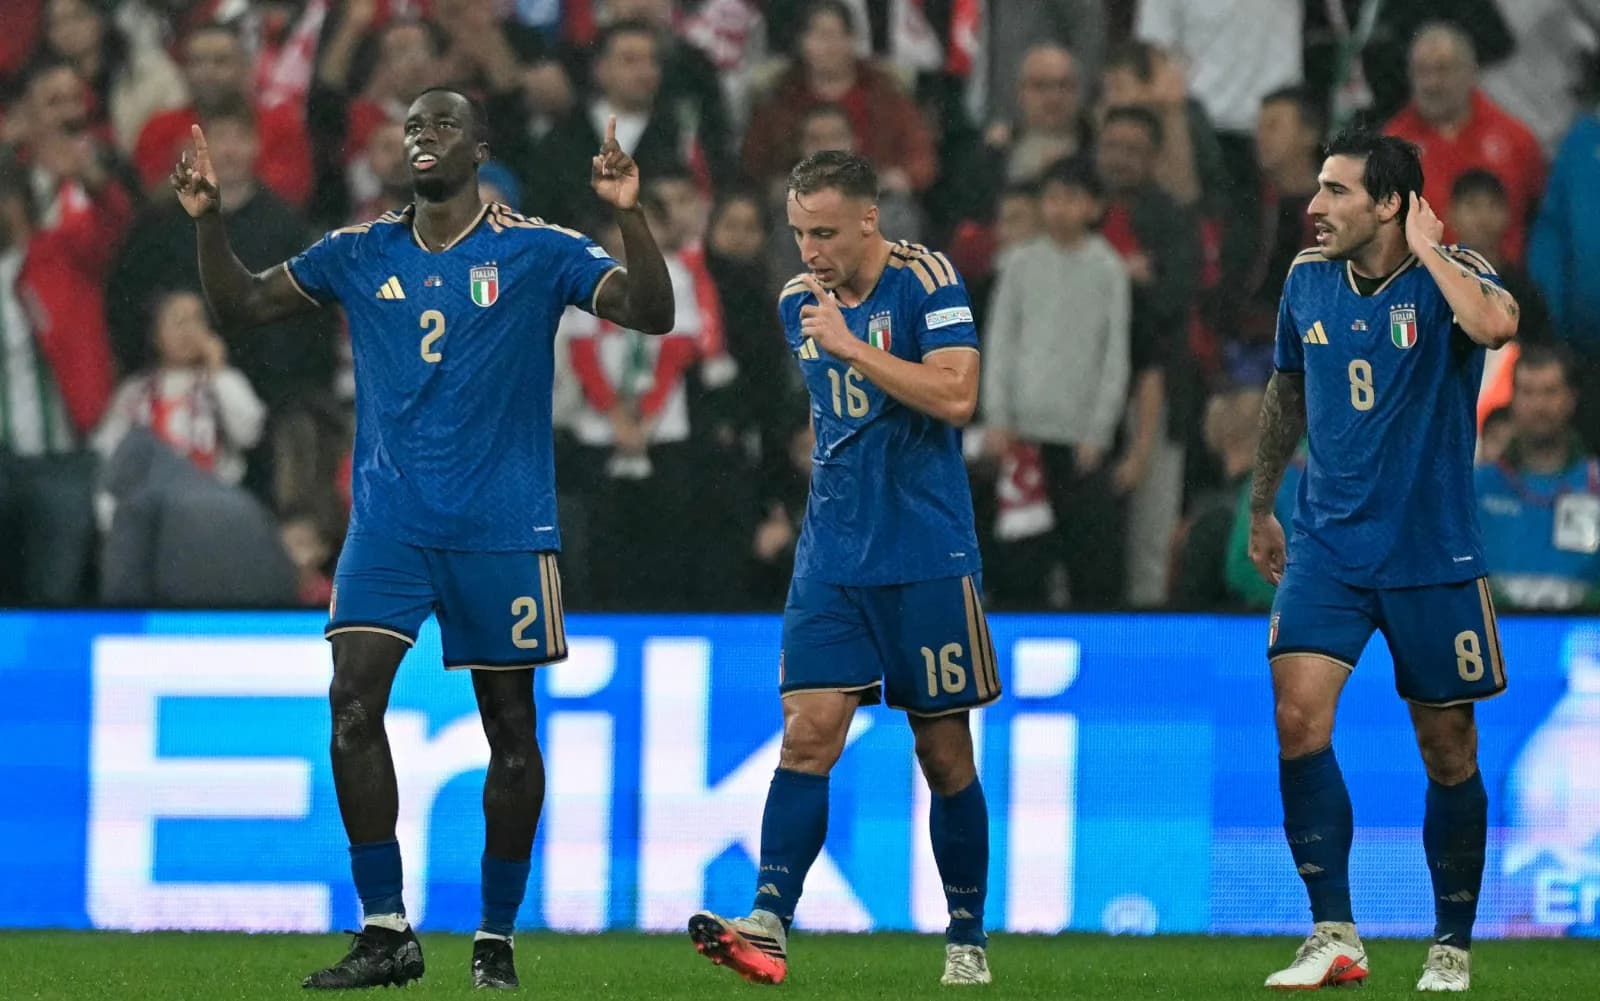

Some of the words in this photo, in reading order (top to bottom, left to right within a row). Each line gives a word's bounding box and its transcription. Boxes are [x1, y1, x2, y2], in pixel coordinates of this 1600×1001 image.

[472, 269, 496, 279] ITALIA
[419, 309, 446, 363] 2
[827, 366, 869, 418] 16
[1348, 358, 1375, 411] 8
[511, 595, 538, 649] 2
[920, 642, 967, 697] 16
[1454, 630, 1485, 682] 8
